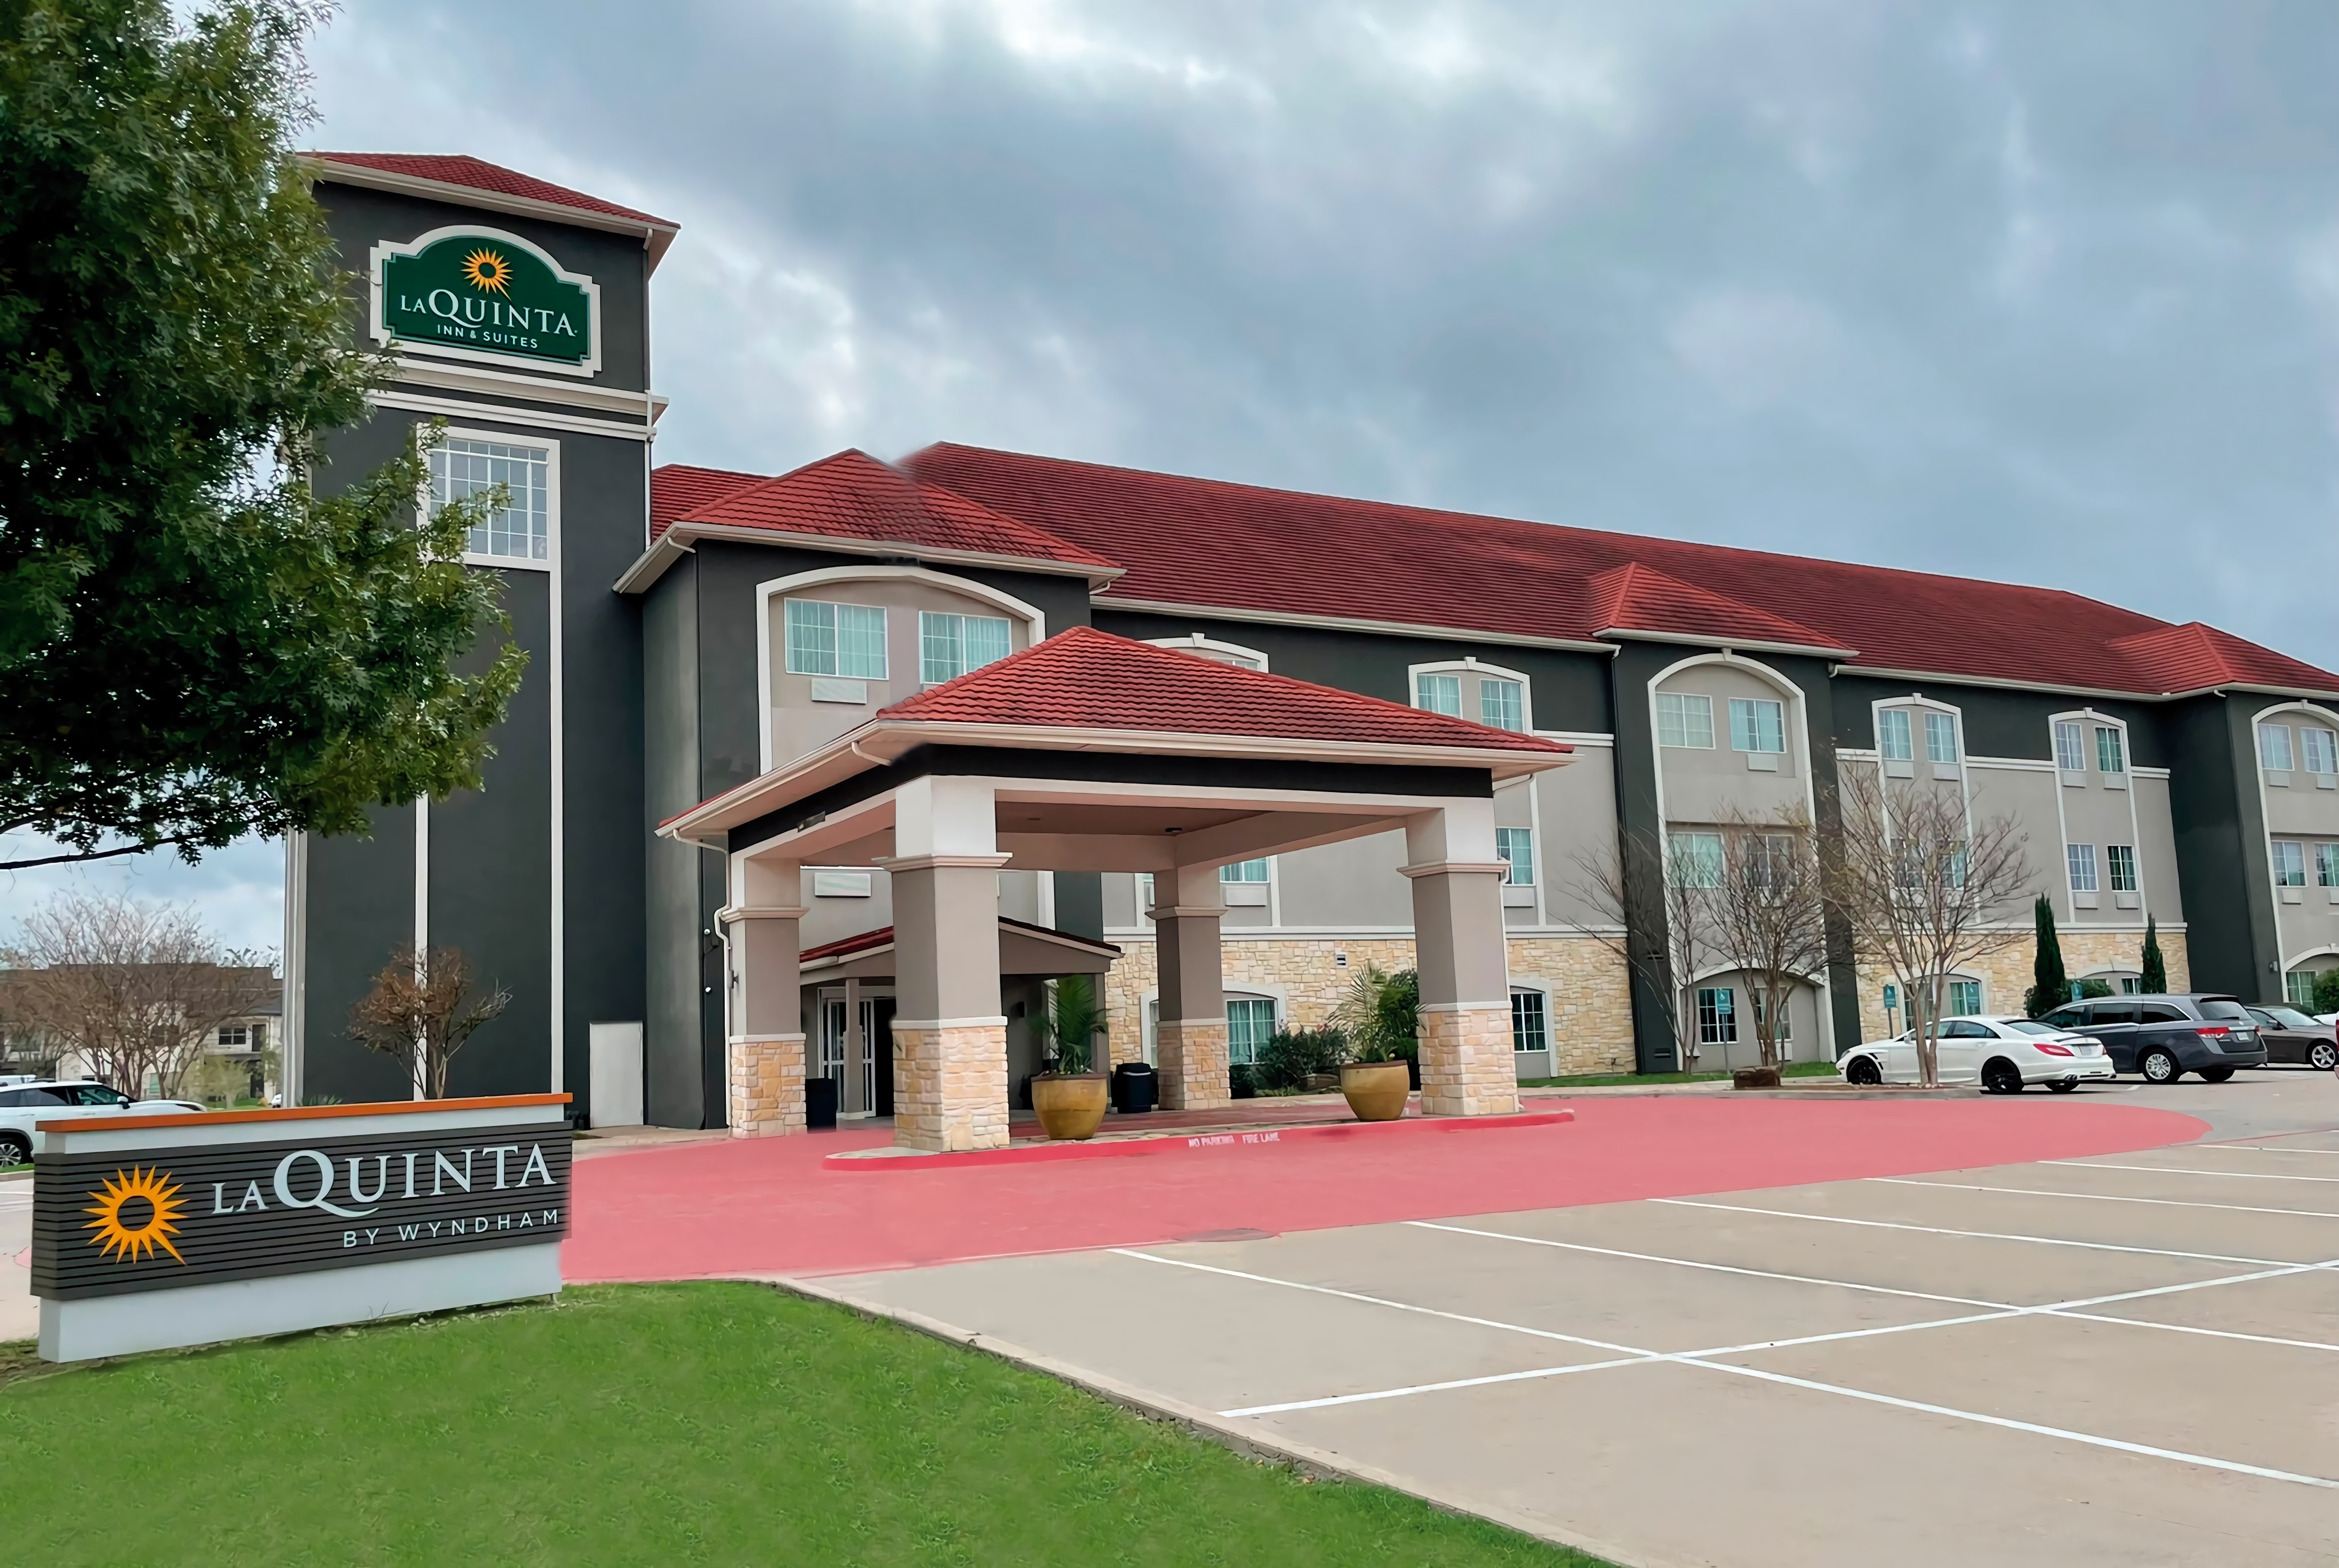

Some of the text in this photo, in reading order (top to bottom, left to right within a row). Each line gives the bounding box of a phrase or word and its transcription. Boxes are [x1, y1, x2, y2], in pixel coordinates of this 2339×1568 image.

[401, 289, 576, 337] LA QUINTA
[437, 324, 464, 337] INN
[483, 331, 538, 349] SUITES
[211, 1143, 558, 1217] LA QUINTA
[344, 1209, 558, 1248] BY WYNDHAM
